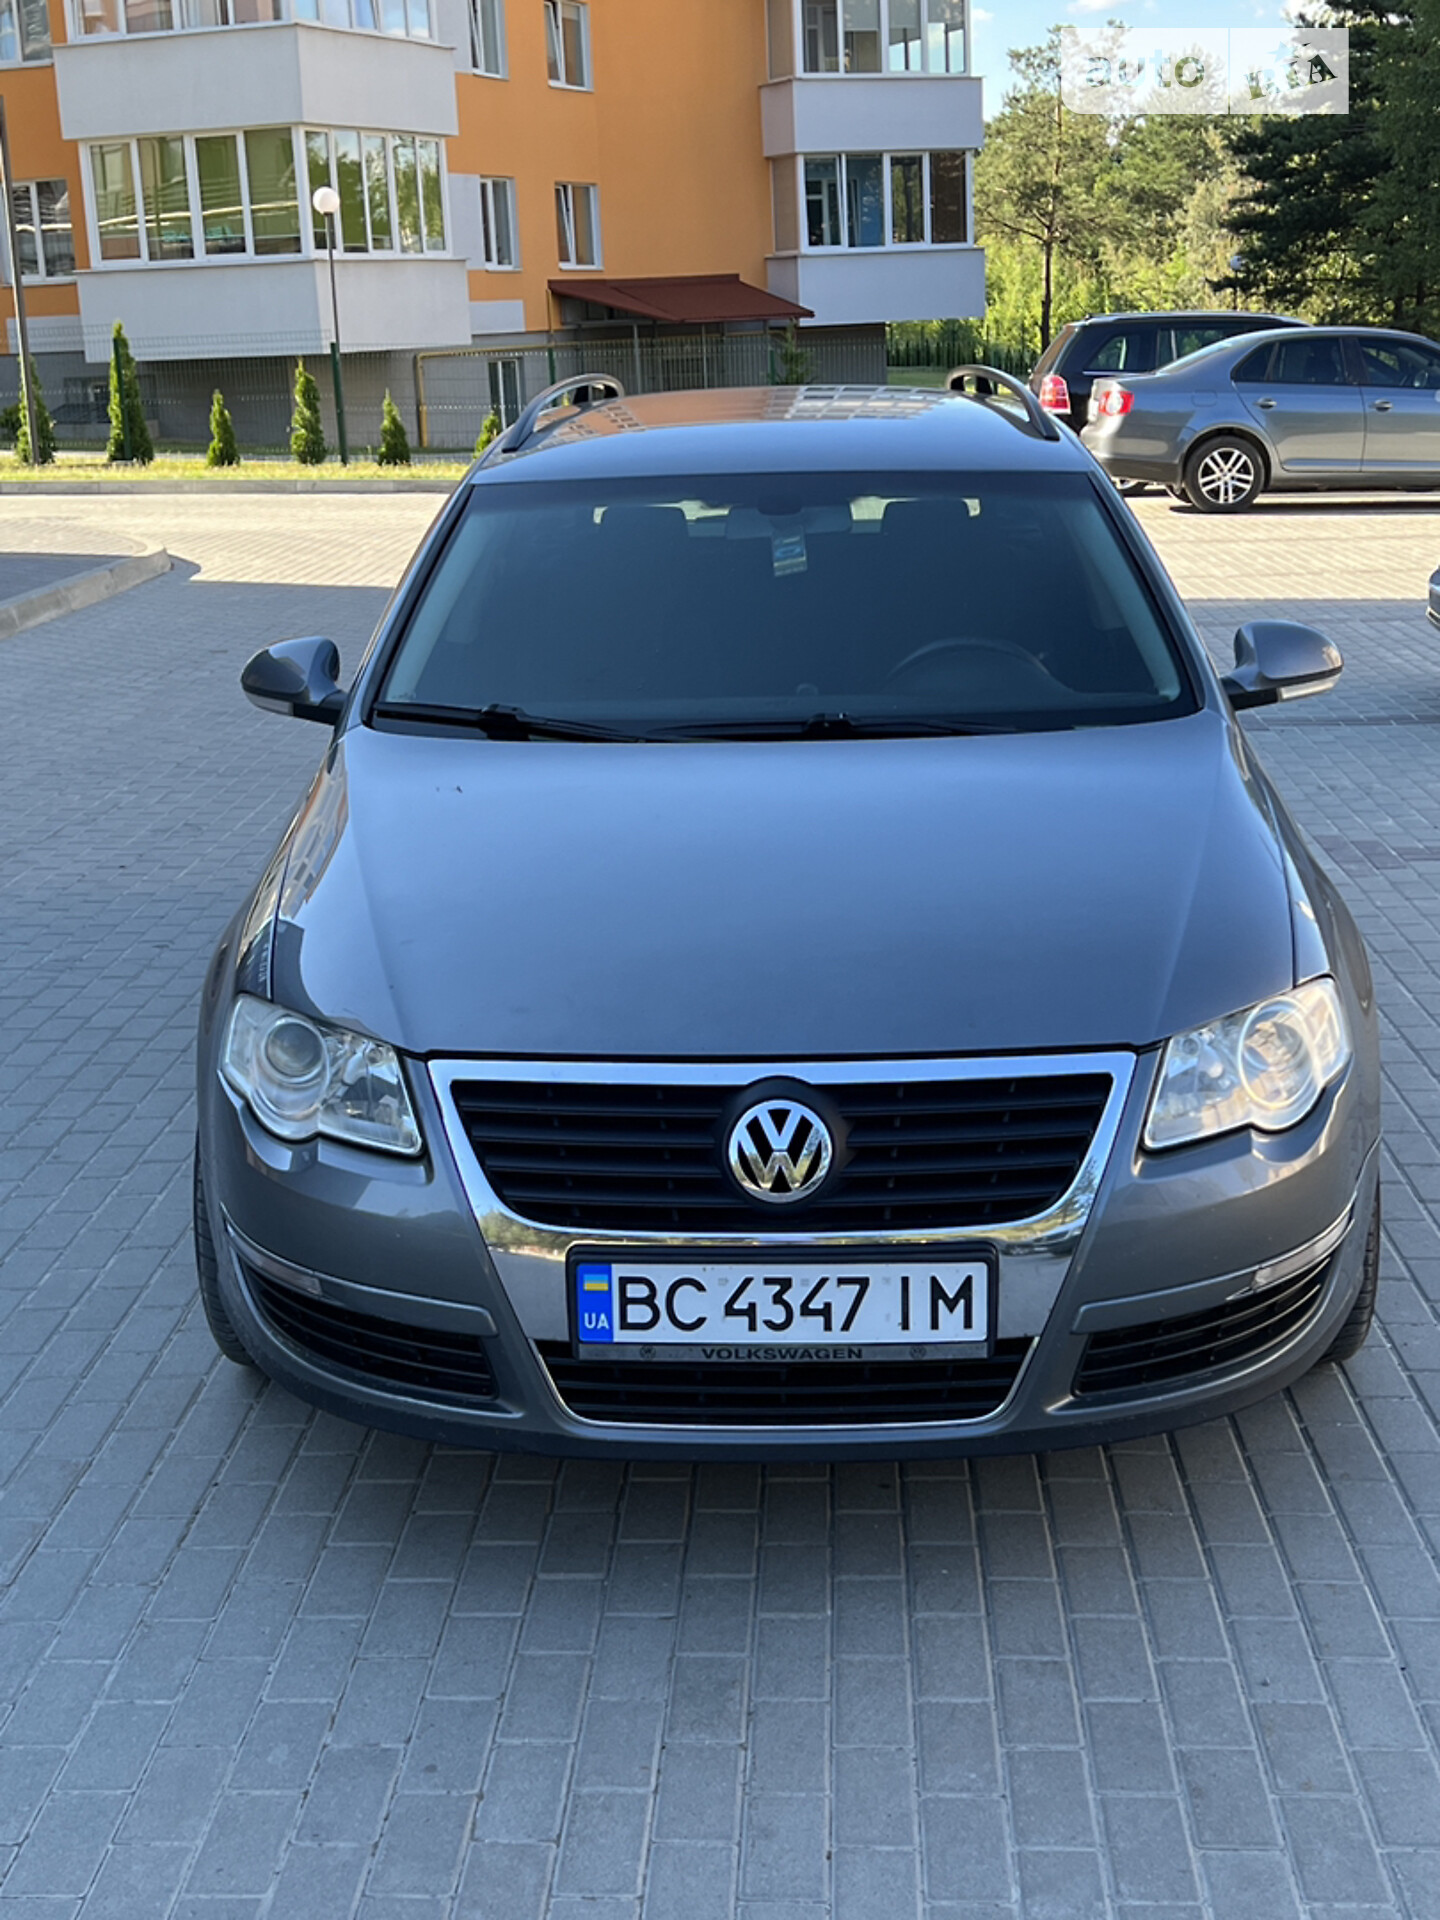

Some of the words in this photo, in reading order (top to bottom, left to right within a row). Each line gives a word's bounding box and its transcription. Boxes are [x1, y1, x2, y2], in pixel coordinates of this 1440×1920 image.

[618, 1275, 708, 1332] BC
[723, 1275, 871, 1333] 4347
[900, 1274, 974, 1331] IM
[583, 1312, 610, 1330] UA
[702, 1347, 863, 1360] VOLKSWAGEN
